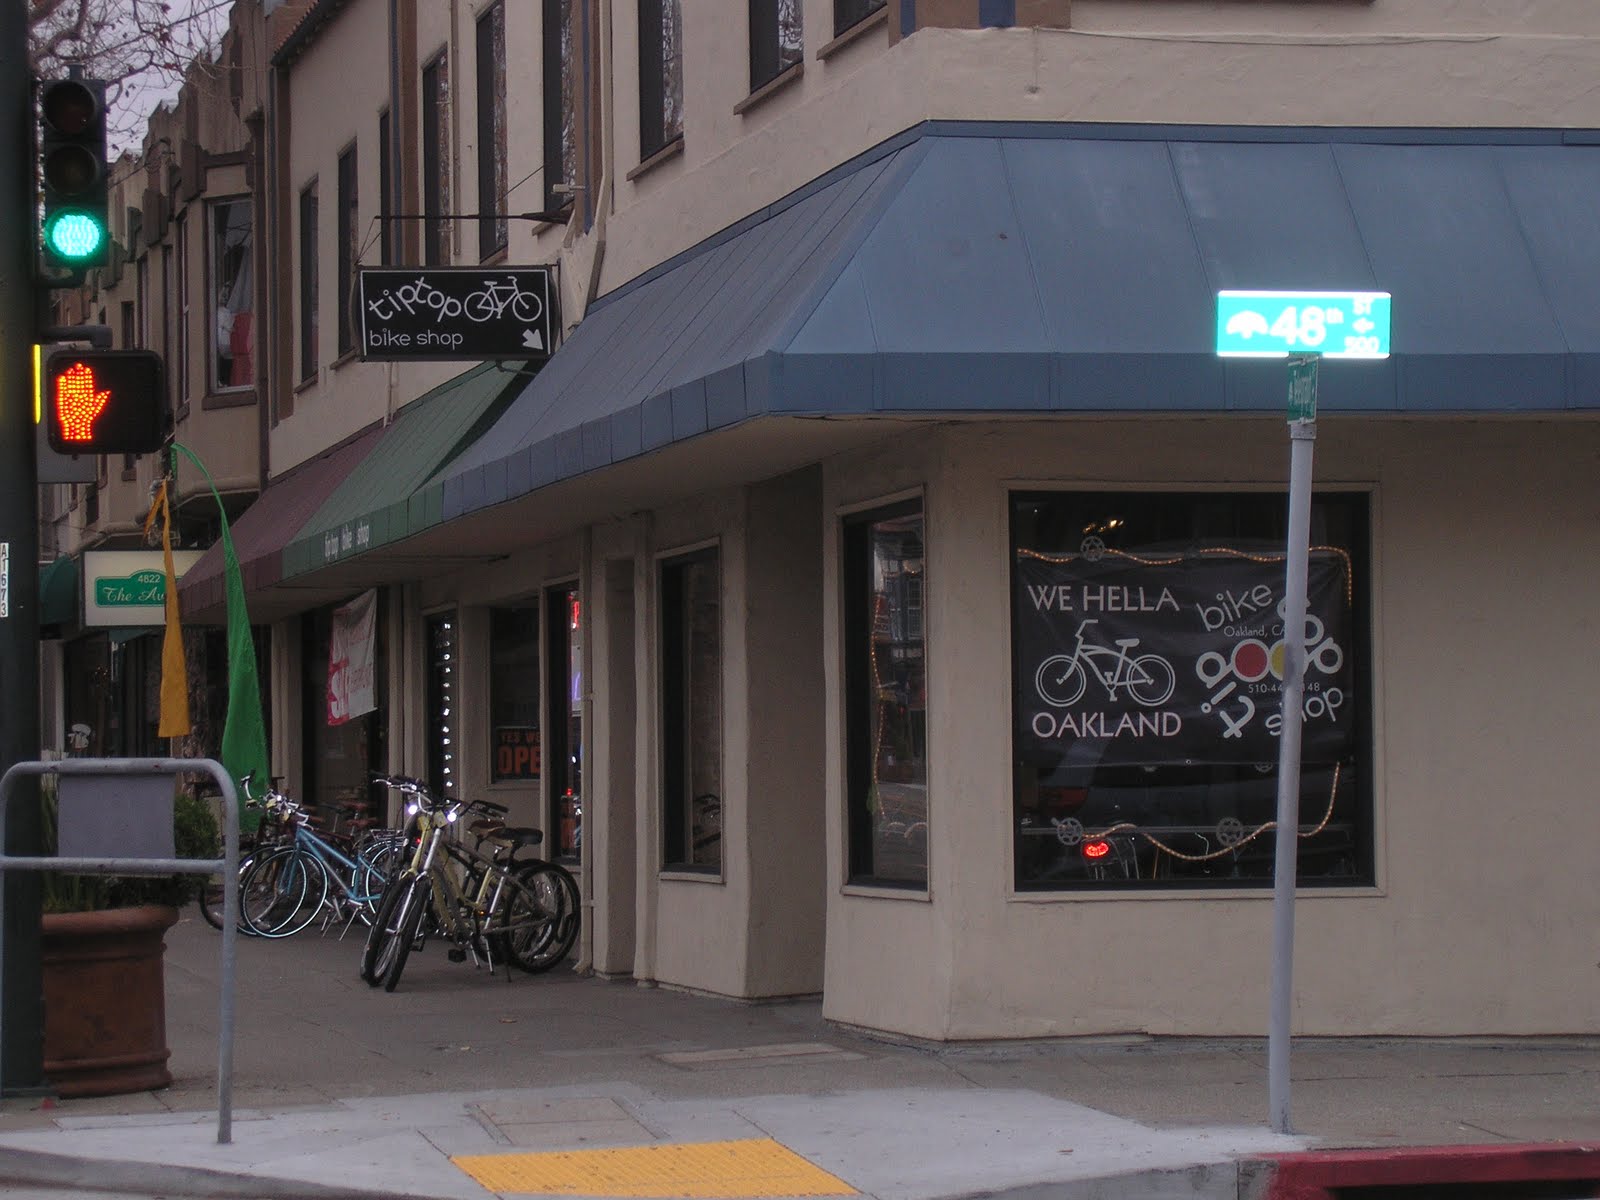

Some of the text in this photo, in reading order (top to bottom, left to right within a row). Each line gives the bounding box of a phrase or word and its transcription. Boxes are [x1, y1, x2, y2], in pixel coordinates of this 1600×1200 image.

[369, 276, 462, 323] tiptop
[370, 328, 463, 350] bike shop
[138, 574, 161, 584] 4822
[103, 586, 134, 602] The
[1027, 585, 1180, 612] WE HELLA
[1196, 584, 1273, 632] bike
[1223, 624, 1268, 638] Oakland,
[1032, 711, 1182, 738] OAKLAND
[498, 746, 540, 775] OPE
